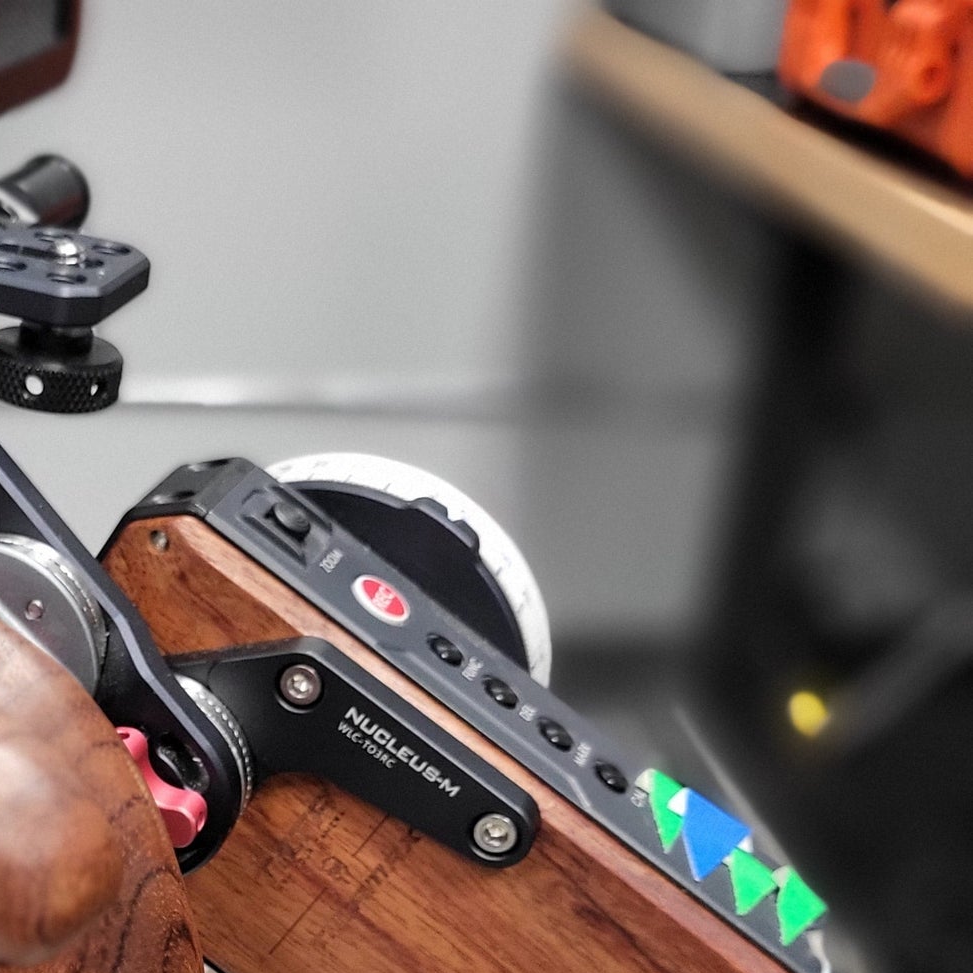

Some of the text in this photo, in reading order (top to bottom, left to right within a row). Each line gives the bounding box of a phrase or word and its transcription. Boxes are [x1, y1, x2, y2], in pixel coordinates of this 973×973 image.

[319, 548, 344, 573] ZOOM
[371, 585, 396, 611] REC
[344, 706, 462, 798] NUCLEUS-M
